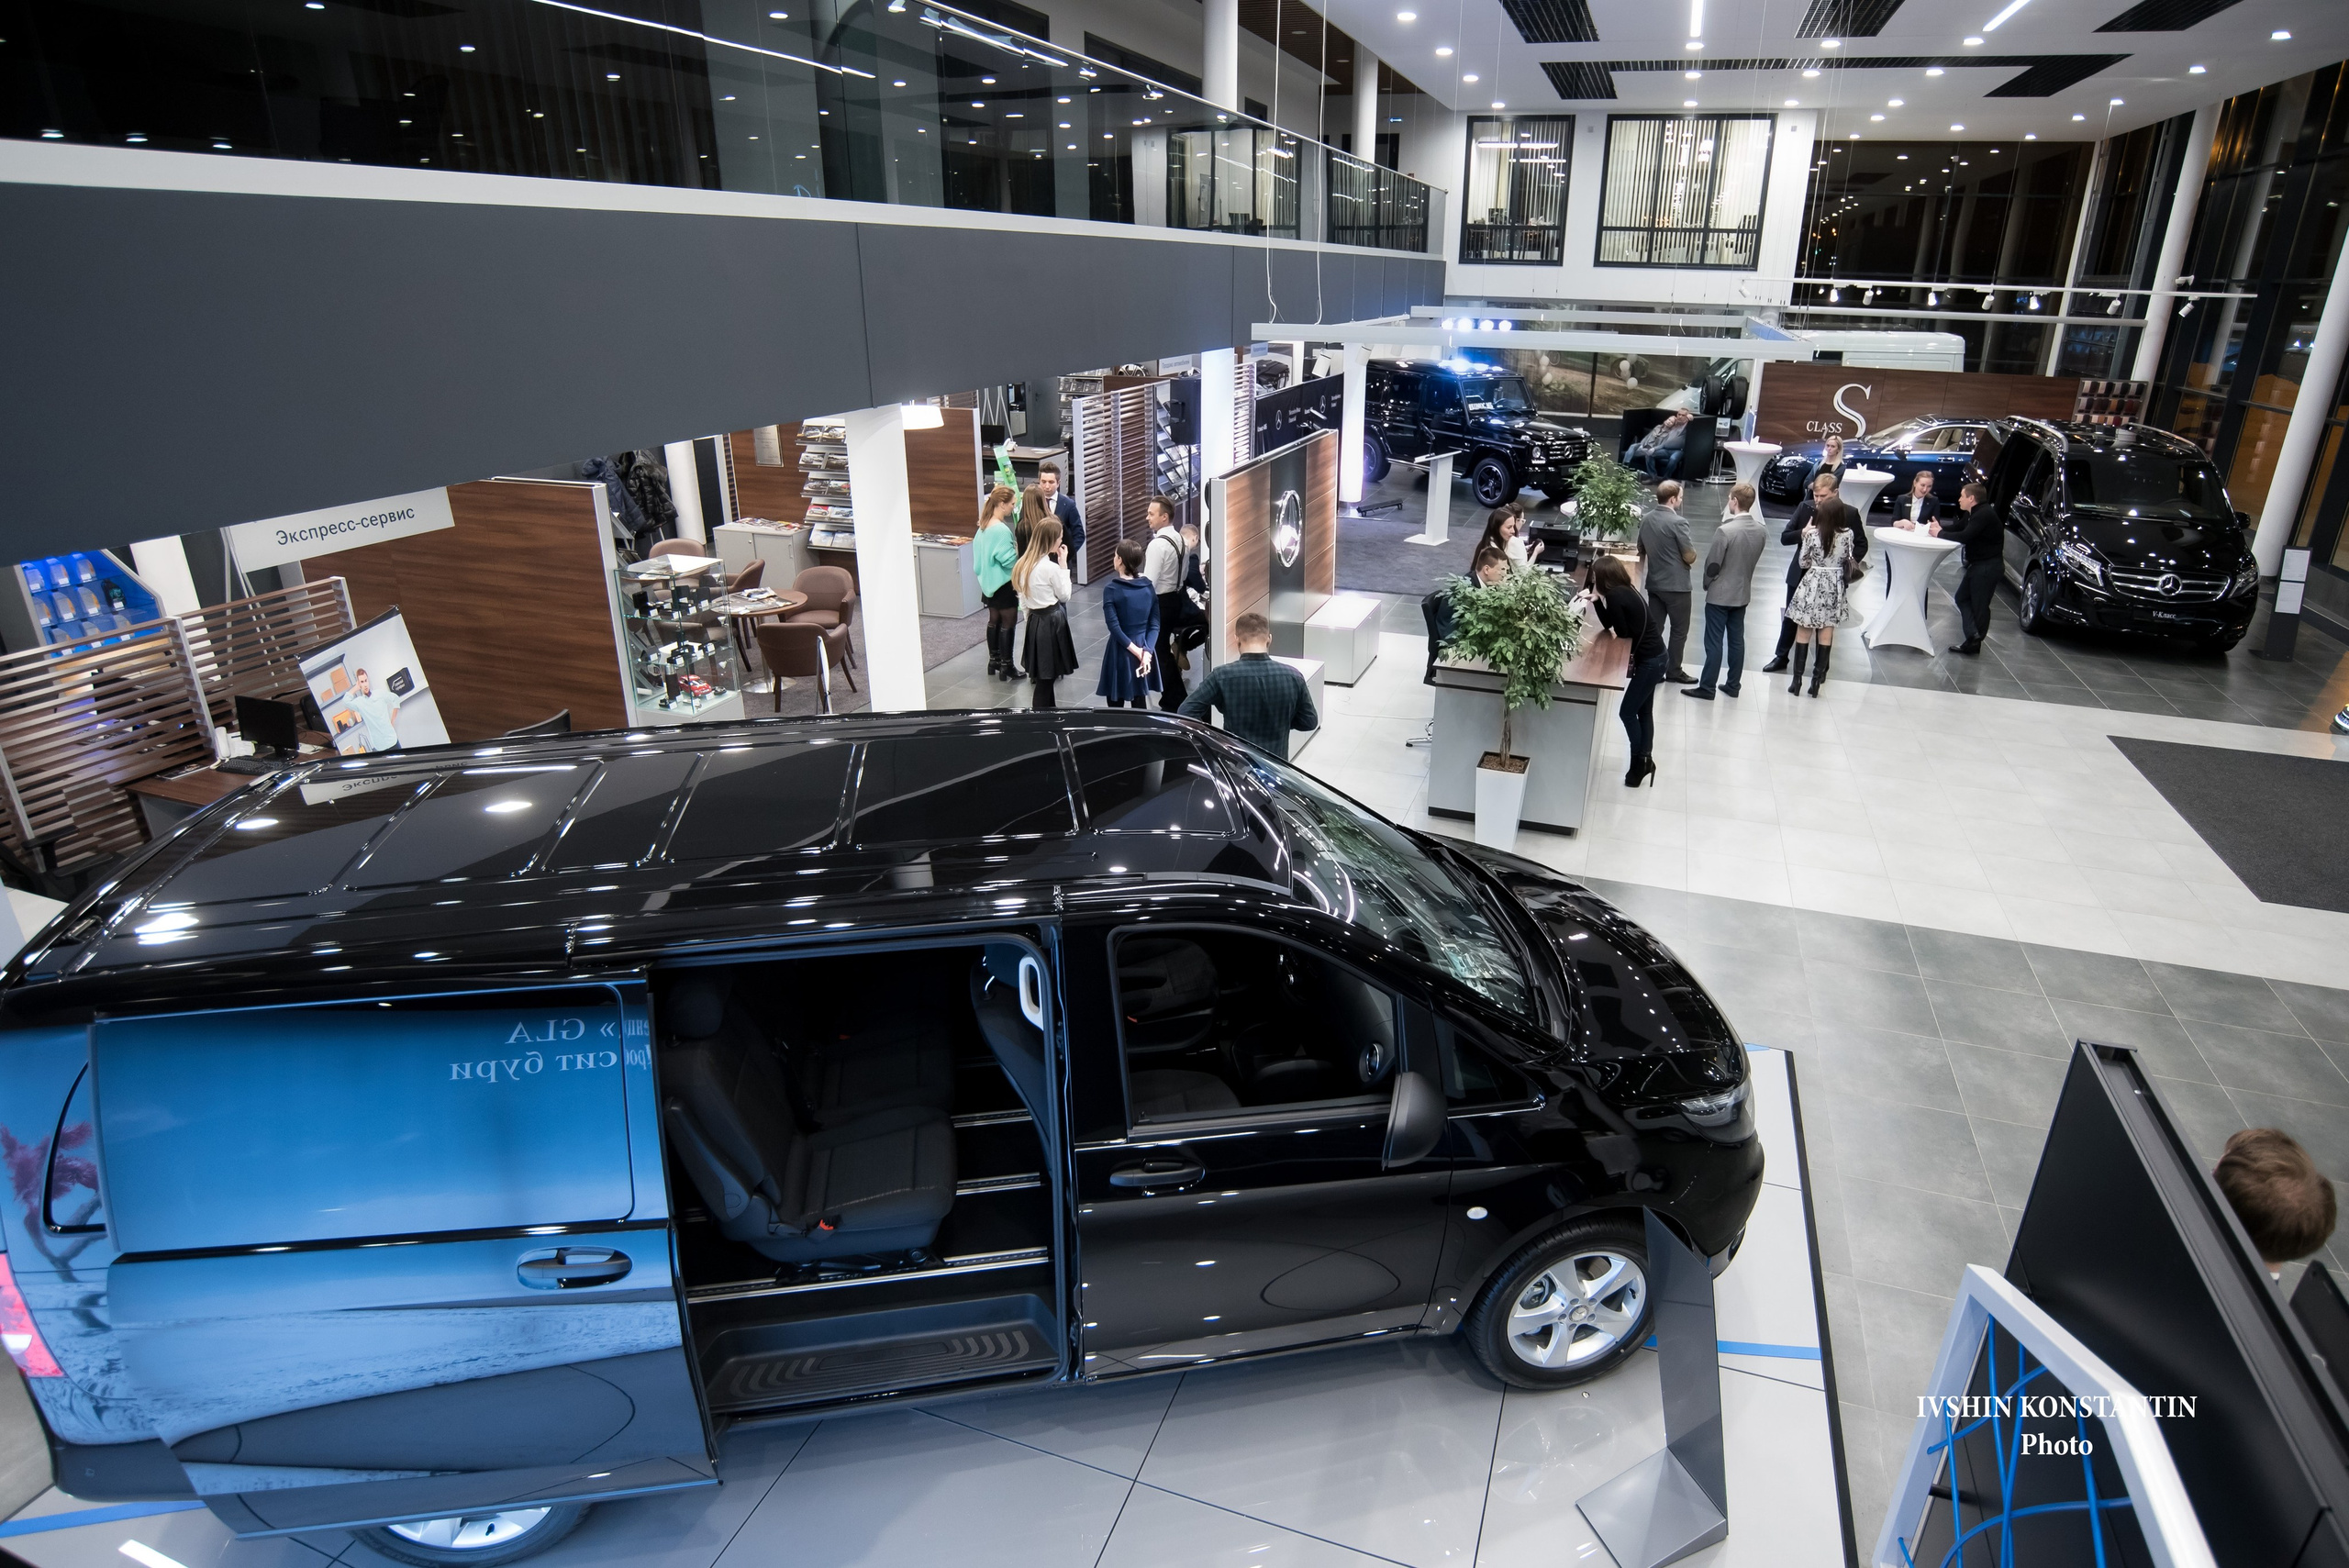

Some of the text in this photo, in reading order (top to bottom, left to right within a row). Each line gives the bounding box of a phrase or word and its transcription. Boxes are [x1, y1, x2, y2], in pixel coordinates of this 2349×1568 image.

[1833, 383, 1872, 439] S
[1806, 420, 1842, 434] CLASS
[275, 507, 416, 546] Экспресс-сервис
[2152, 610, 2176, 619] V-Класс
